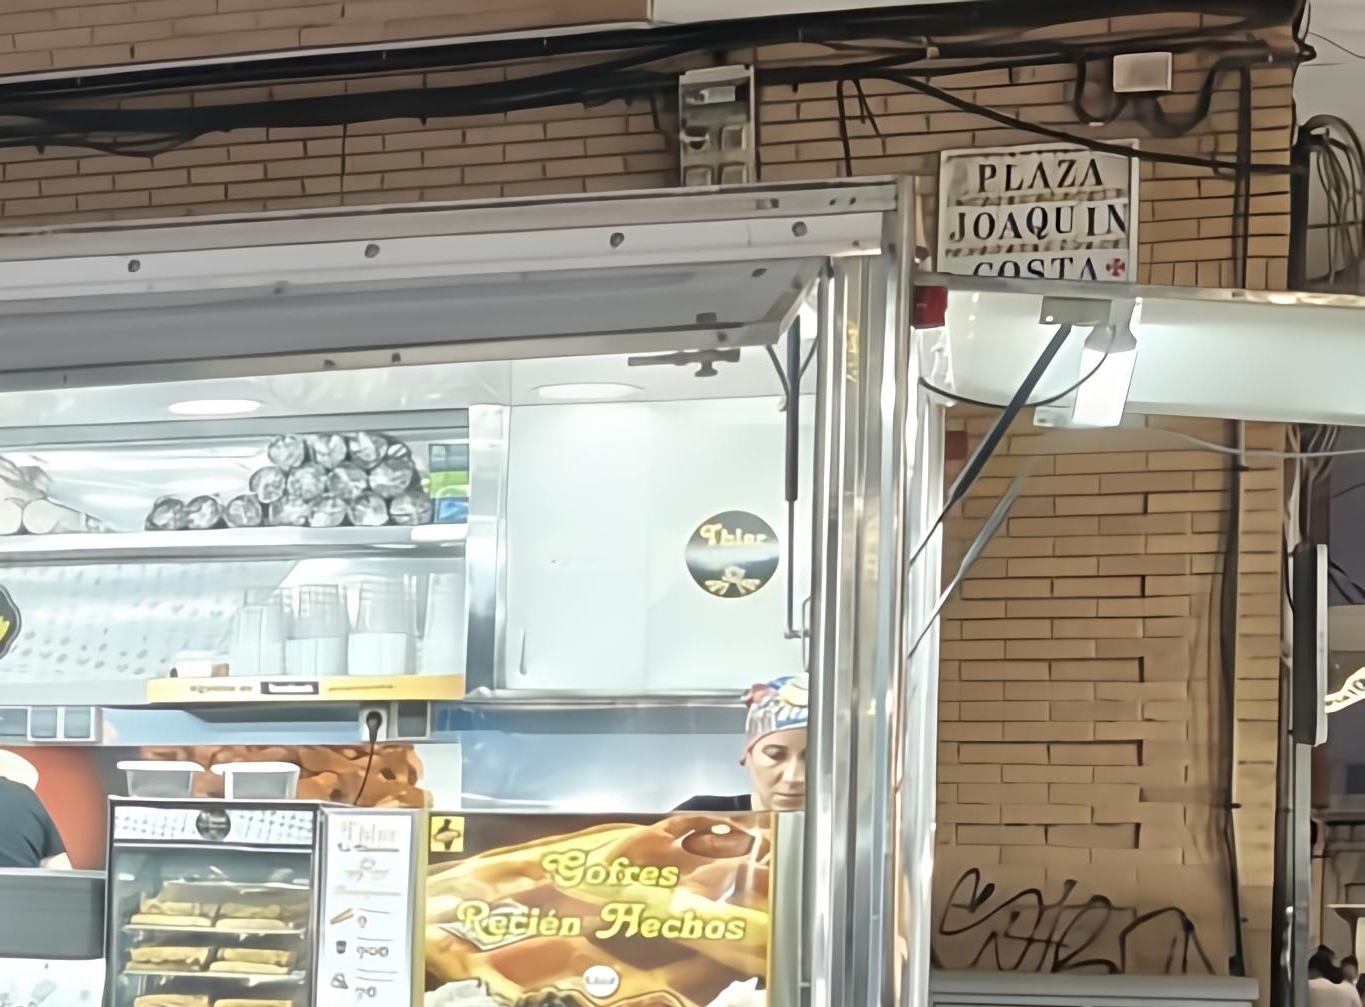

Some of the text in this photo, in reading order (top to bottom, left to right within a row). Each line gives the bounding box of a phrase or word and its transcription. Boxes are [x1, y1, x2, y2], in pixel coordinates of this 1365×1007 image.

[978, 158, 1104, 194] PLAZA
[949, 203, 1127, 242] JOAQUIN
[542, 850, 679, 888] Gofres
[456, 900, 747, 943] Recién Hechos
